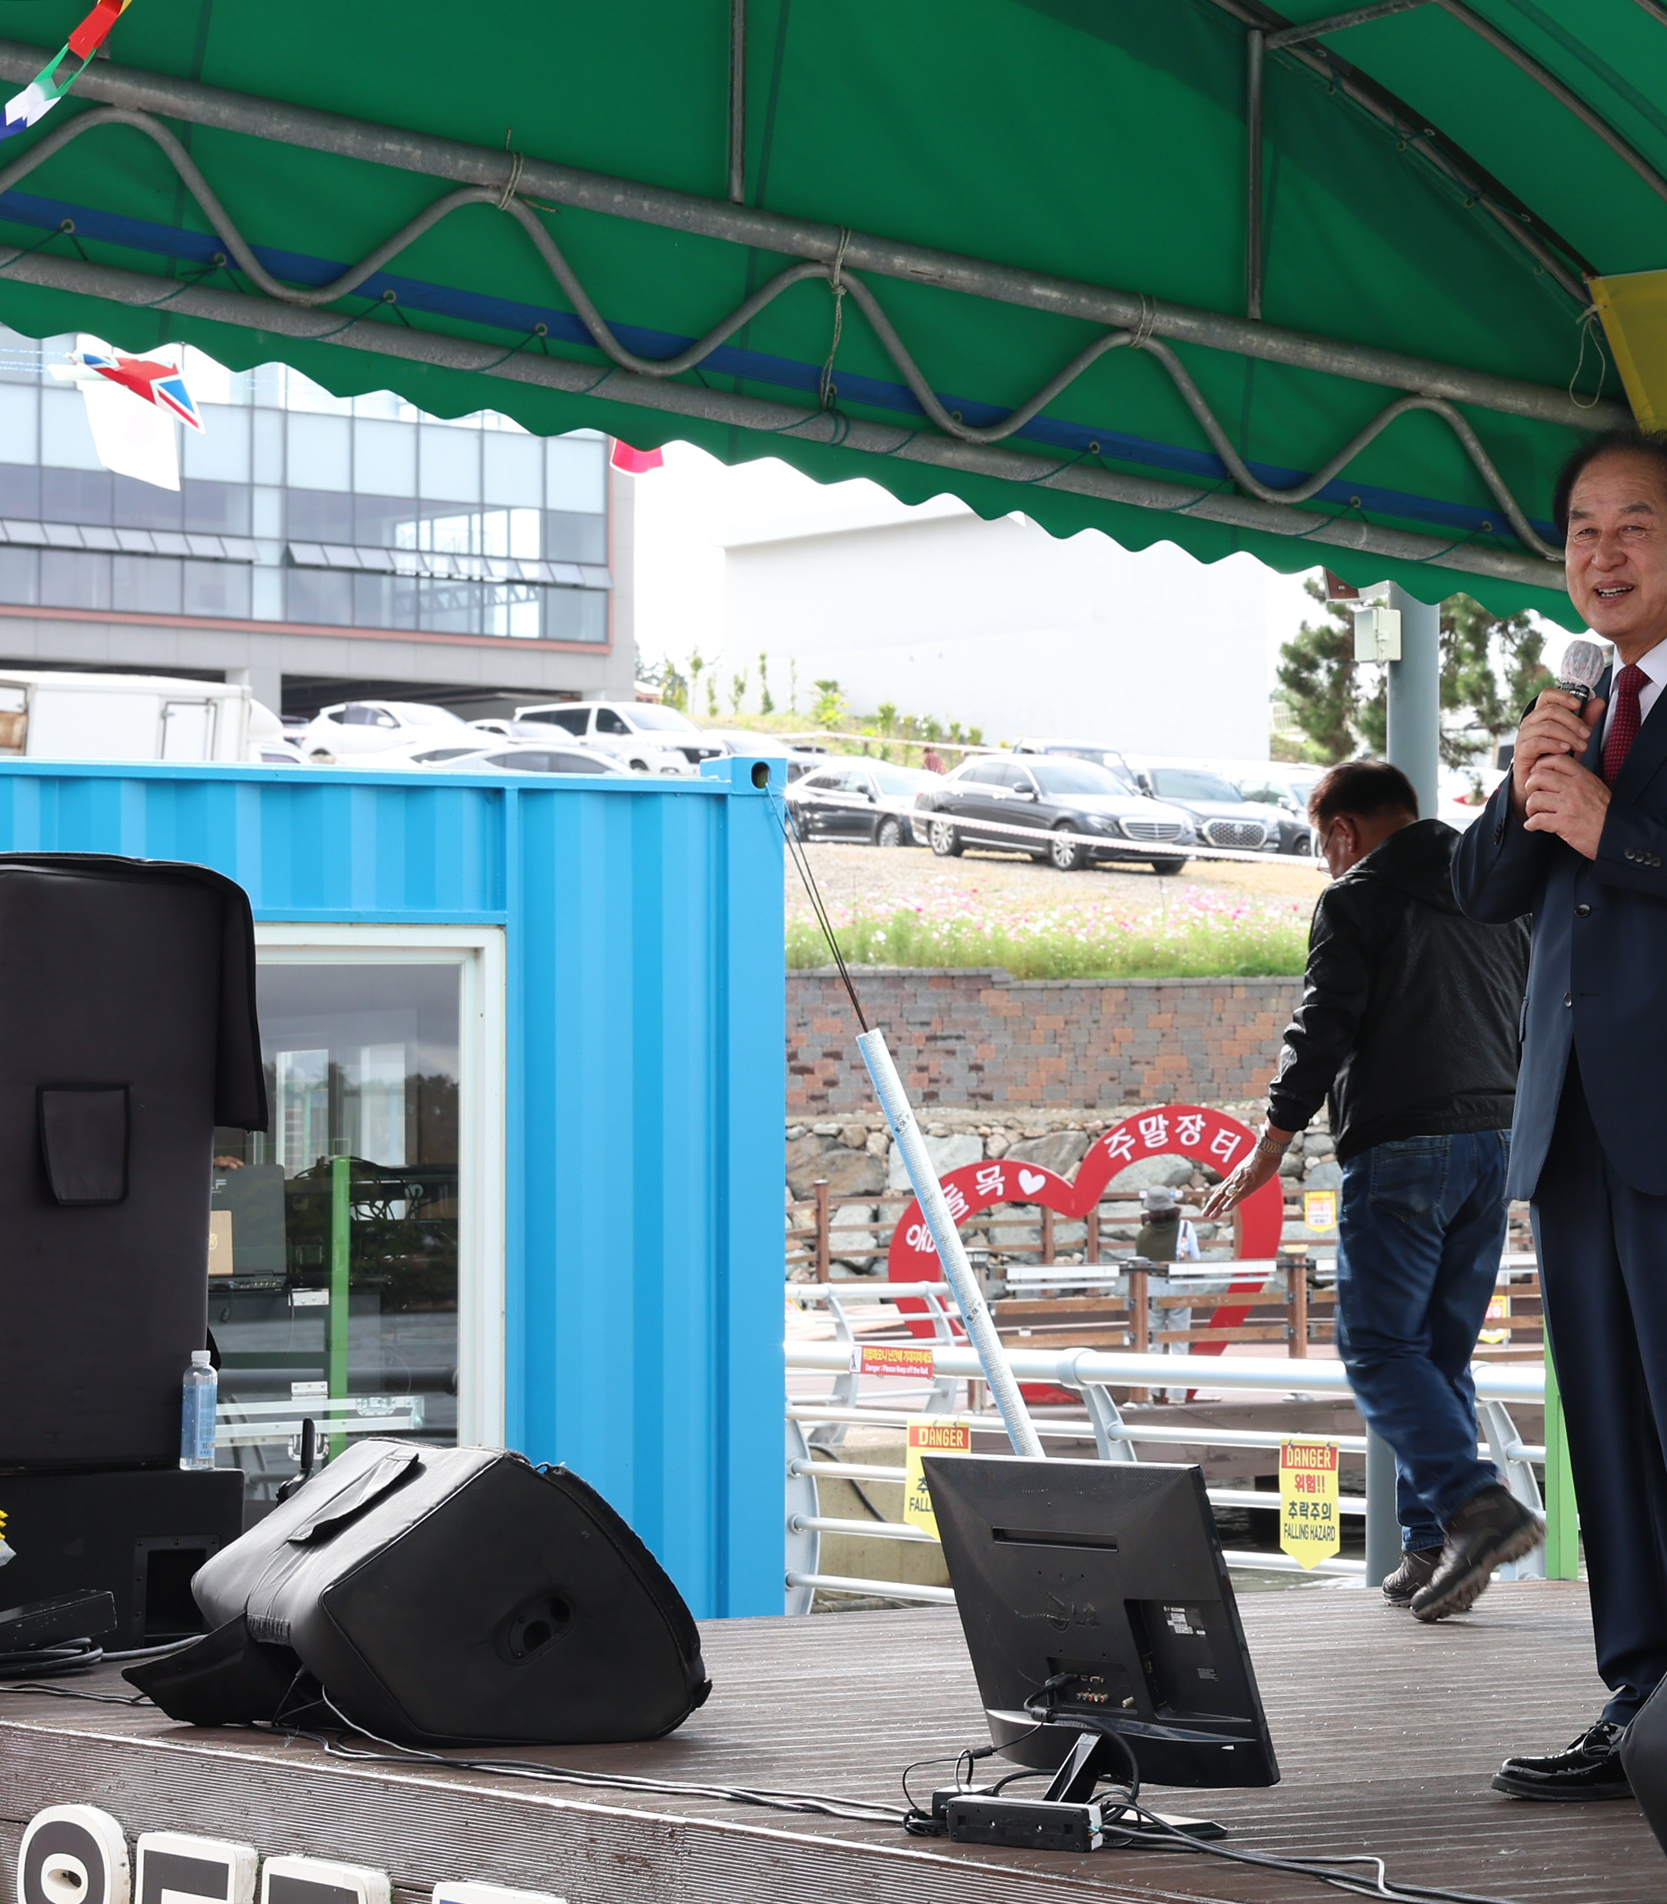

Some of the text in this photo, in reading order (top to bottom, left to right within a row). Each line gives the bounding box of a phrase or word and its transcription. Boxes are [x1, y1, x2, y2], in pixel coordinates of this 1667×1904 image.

[1103, 1113, 1242, 1163] 주말장터
[918, 1428, 964, 1447] DANGER
[1286, 1448, 1332, 1468] DANGER
[1295, 1473, 1325, 1493] 위험!!
[909, 1497, 934, 1512] FALL
[1288, 1500, 1332, 1521] 추락주의
[1284, 1523, 1336, 1542] FALLING HAZARD
